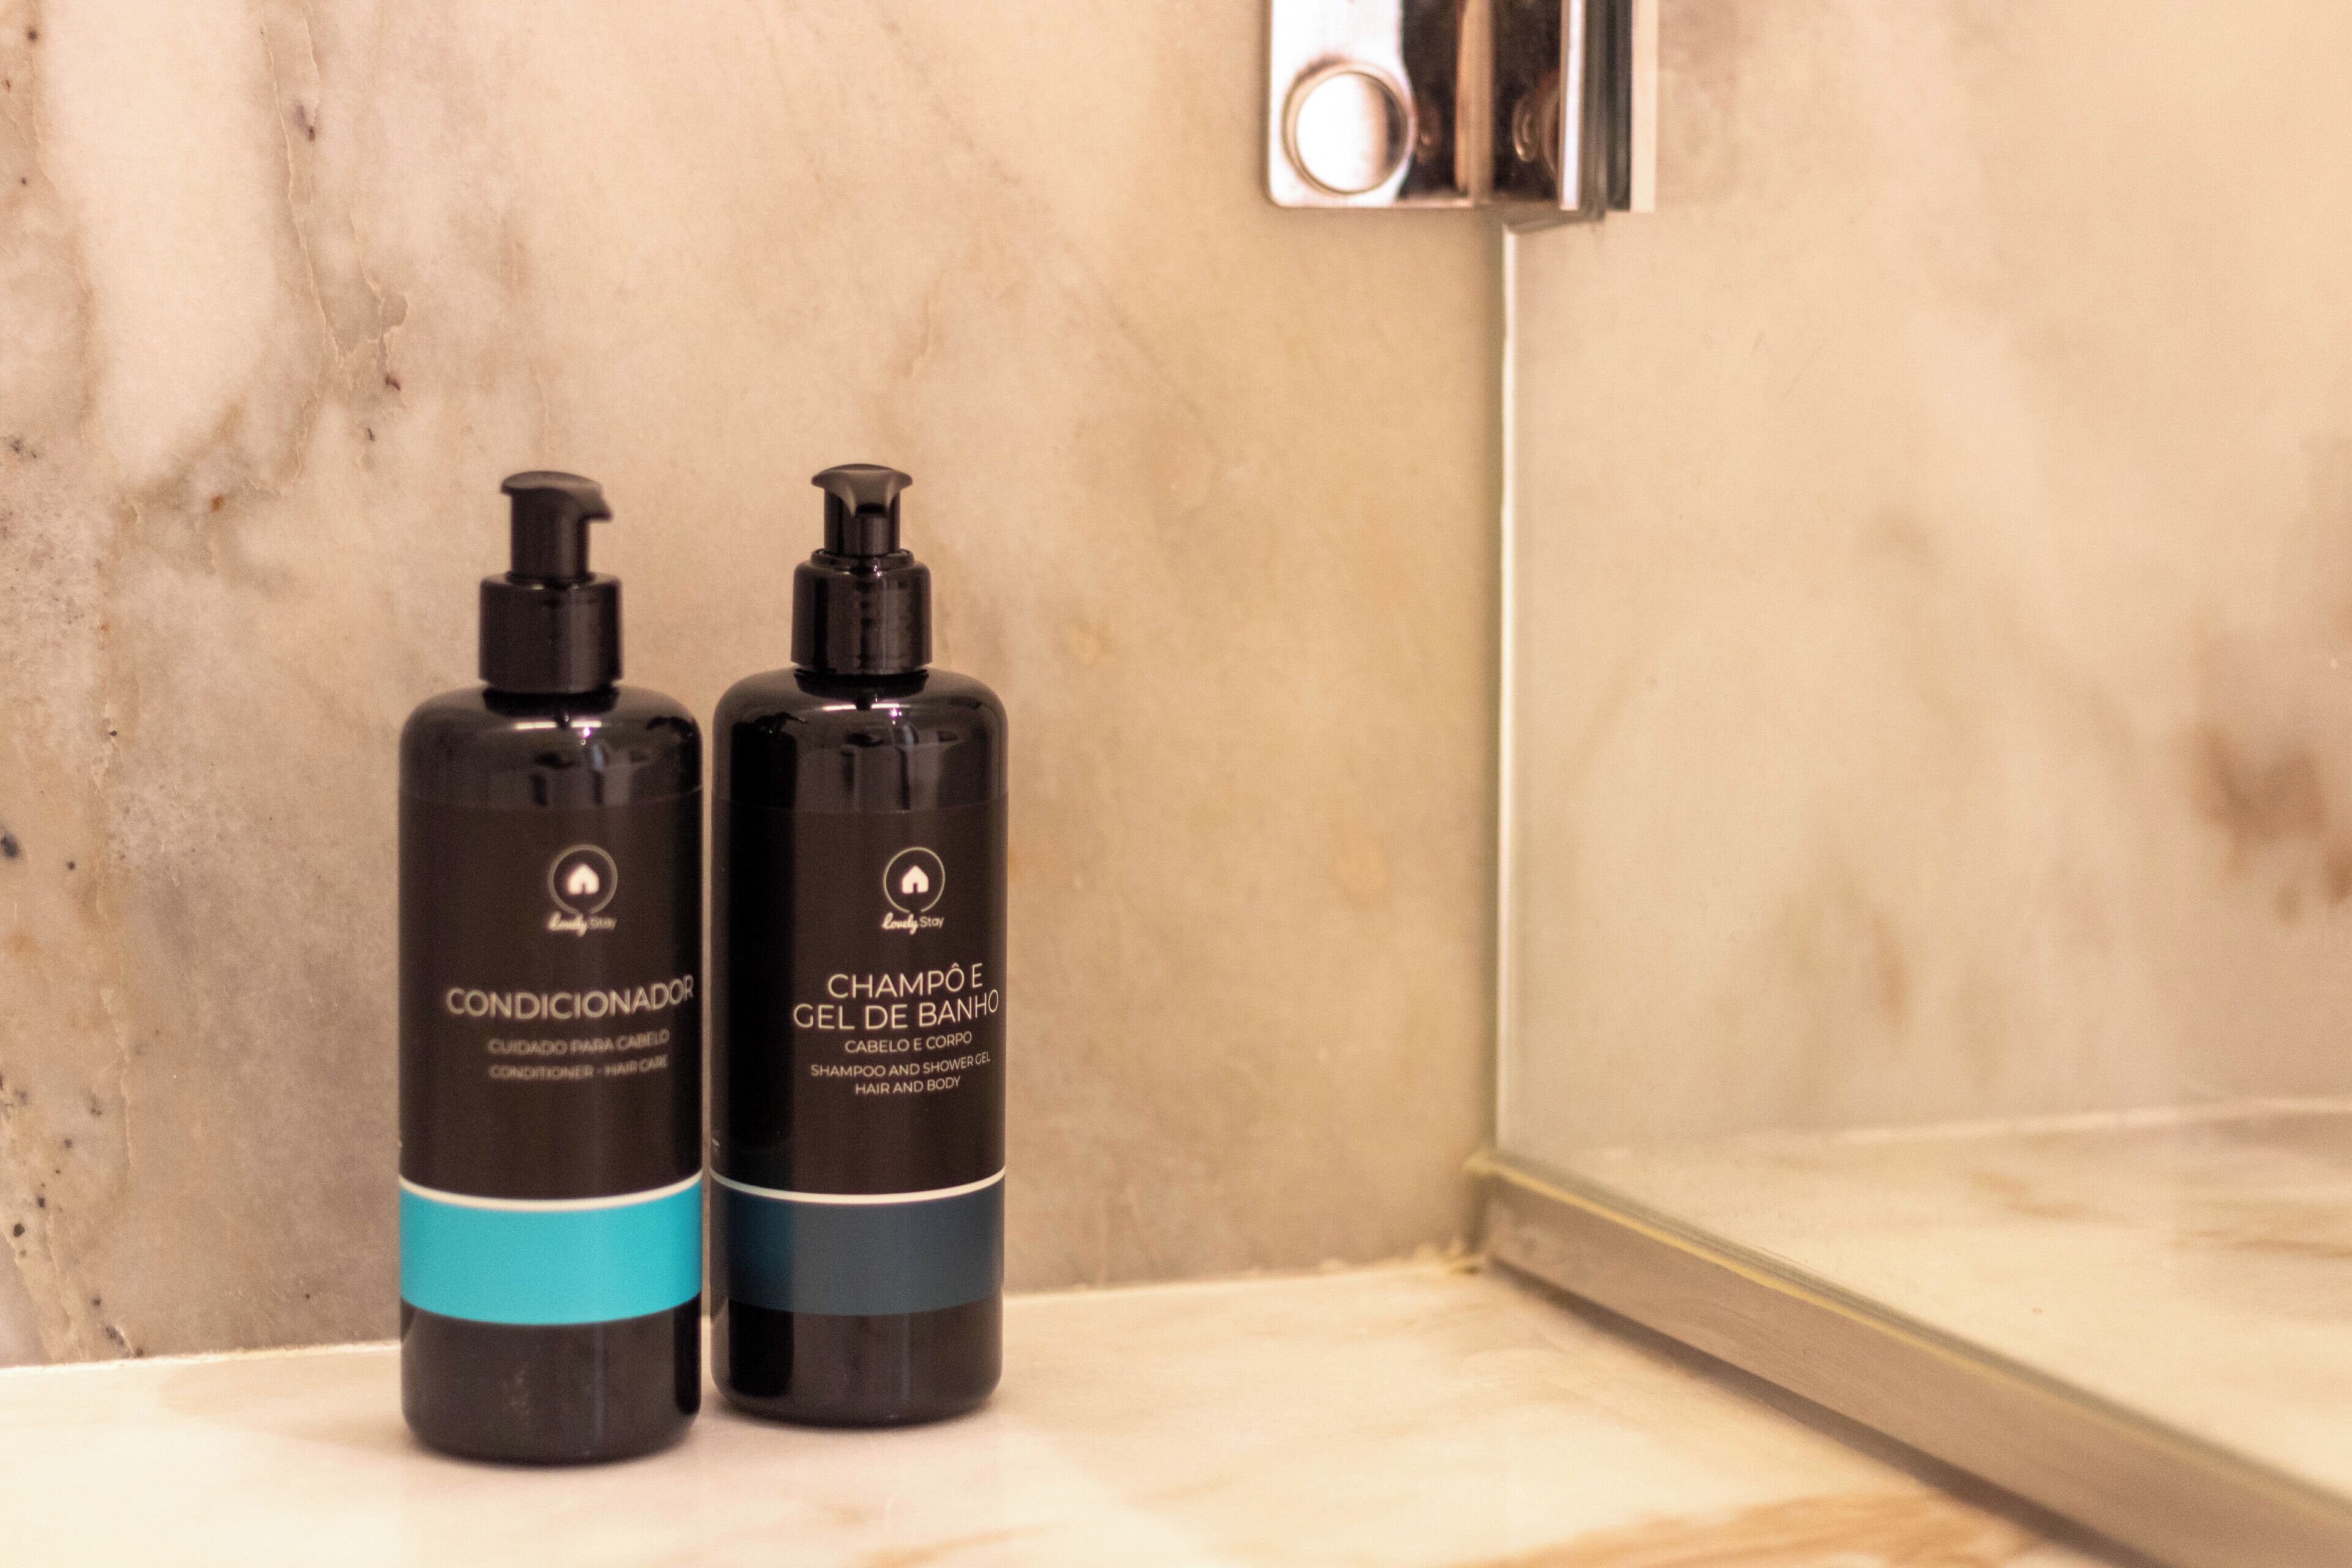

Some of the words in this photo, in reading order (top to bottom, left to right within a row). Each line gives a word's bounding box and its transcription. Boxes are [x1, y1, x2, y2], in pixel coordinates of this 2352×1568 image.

[919, 916, 944, 929] Stay
[827, 962, 965, 1000] CHAMPÔ
[971, 963, 982, 988] E
[446, 974, 694, 1020] CONDICIONADOR
[793, 1003, 855, 1030] GEL
[865, 1004, 908, 1030] DE
[919, 989, 999, 1027] BANHO
[488, 1039, 568, 1055] CUIDADO
[570, 1038, 613, 1054] PARA
[614, 1028, 669, 1050] CABELO
[845, 1039, 910, 1053] CABELO
[913, 1038, 922, 1051] E
[926, 1031, 972, 1049] CORPO
[490, 1064, 594, 1080] CONDITIONER
[605, 1060, 637, 1077] HAIR
[638, 1054, 668, 1072] CARE
[810, 1064, 886, 1077] SHAMPOO
[888, 1063, 920, 1076] AND
[923, 1055, 973, 1073] SHOWER
[975, 1051, 990, 1065] GEL
[855, 1082, 889, 1095] HAIR
[892, 1080, 924, 1094] AND
[927, 1075, 960, 1091] BODY
